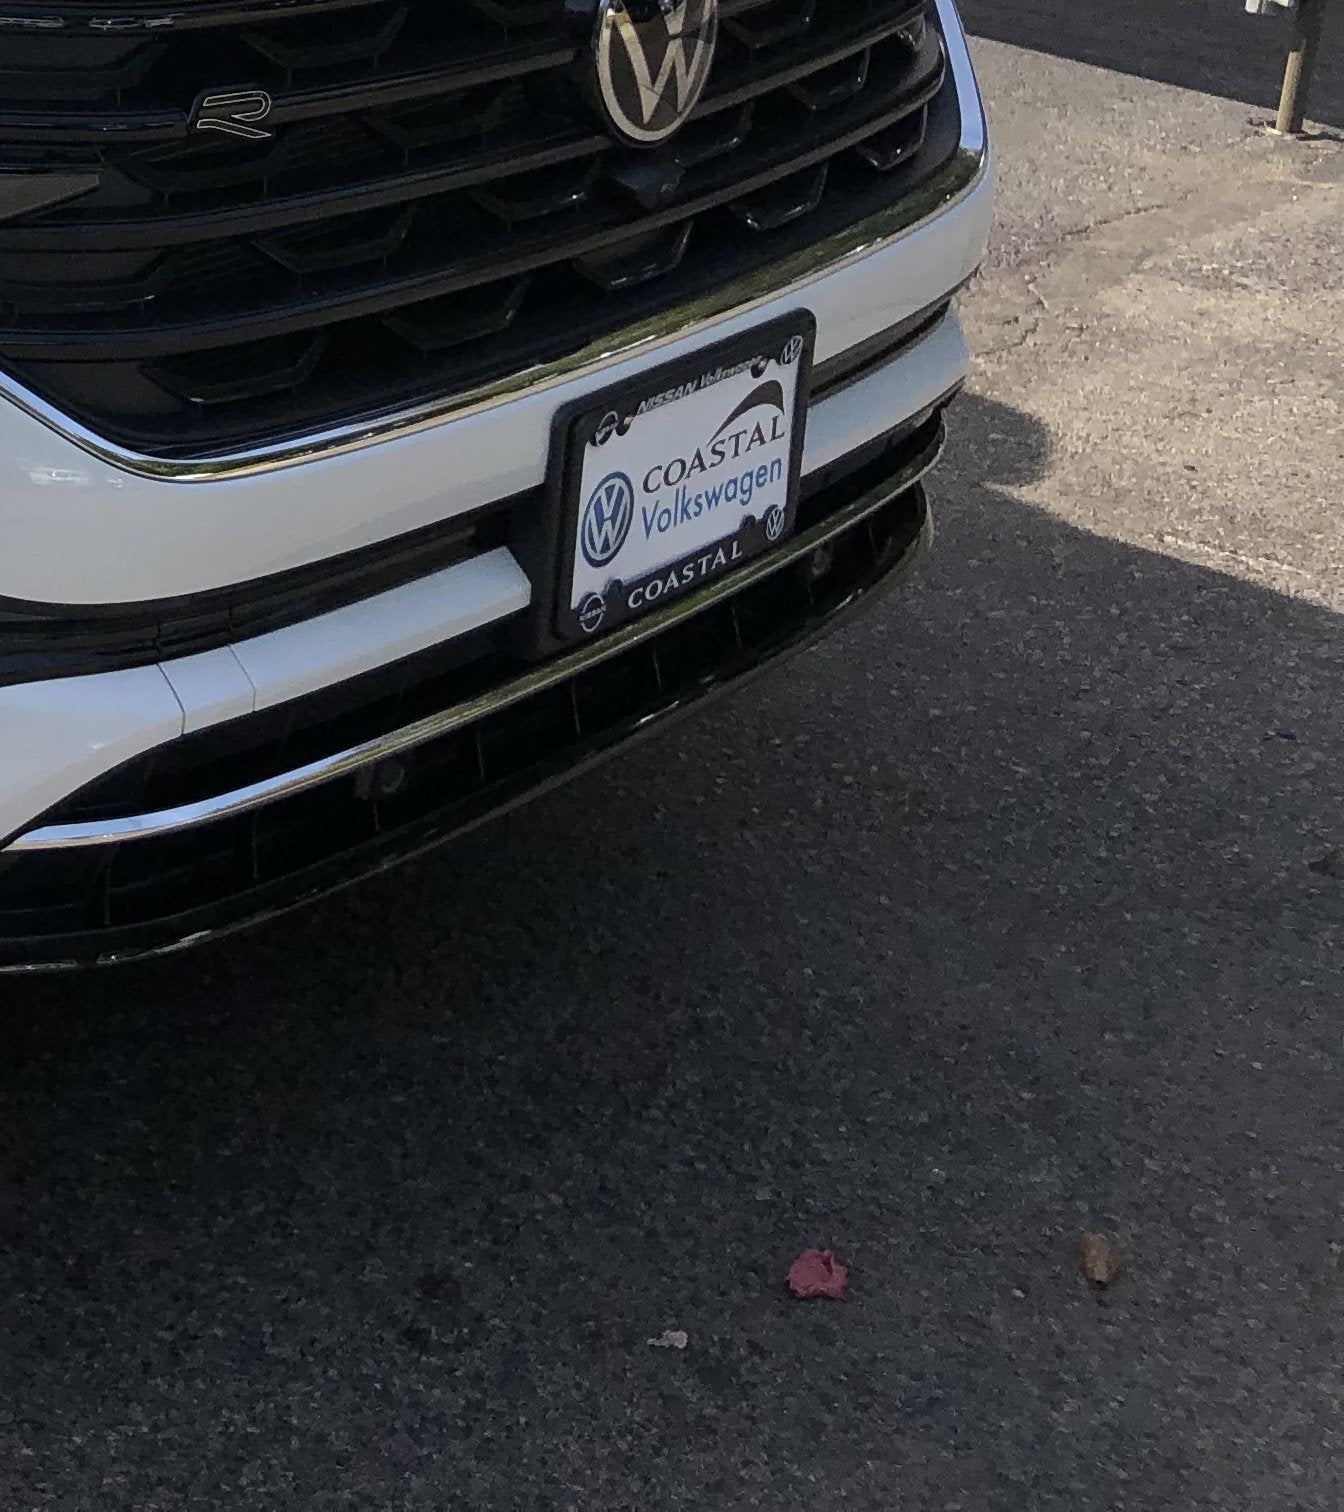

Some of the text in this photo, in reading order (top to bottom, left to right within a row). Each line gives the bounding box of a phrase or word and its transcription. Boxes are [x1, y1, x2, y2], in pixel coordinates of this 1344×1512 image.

[642, 415, 786, 494] COASTAL
[641, 458, 783, 540] Volkswagen
[627, 540, 743, 609] COASTAL
